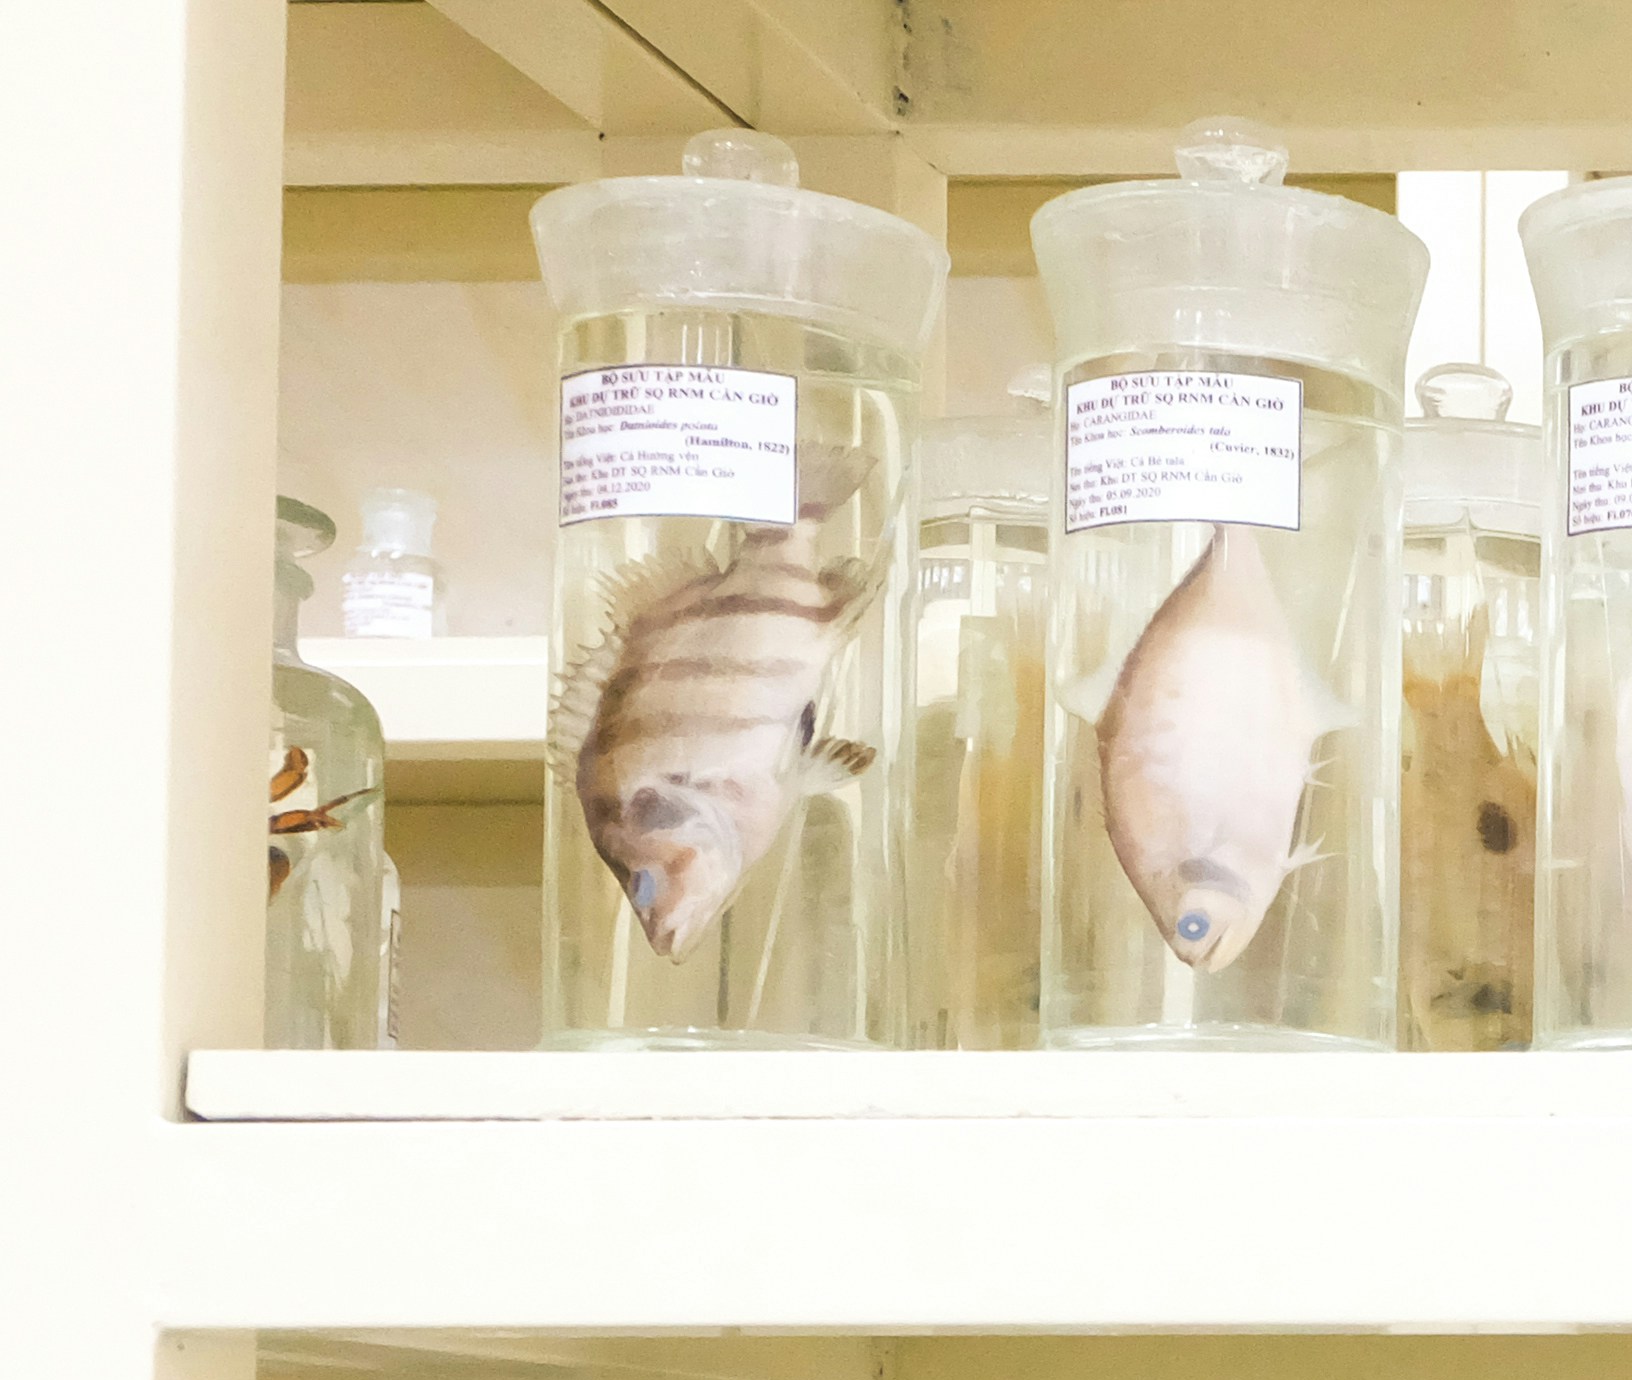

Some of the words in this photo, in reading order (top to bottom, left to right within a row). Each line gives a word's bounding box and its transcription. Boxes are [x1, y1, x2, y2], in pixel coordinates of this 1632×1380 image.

[669, 389, 703, 399] RNM
[1077, 400, 1098, 414] KHU
[1155, 393, 1173, 404] SQ
[1179, 393, 1213, 403] RNM
[1581, 402, 1603, 416] KHU
[1084, 411, 1156, 427] CARANGIDAE
